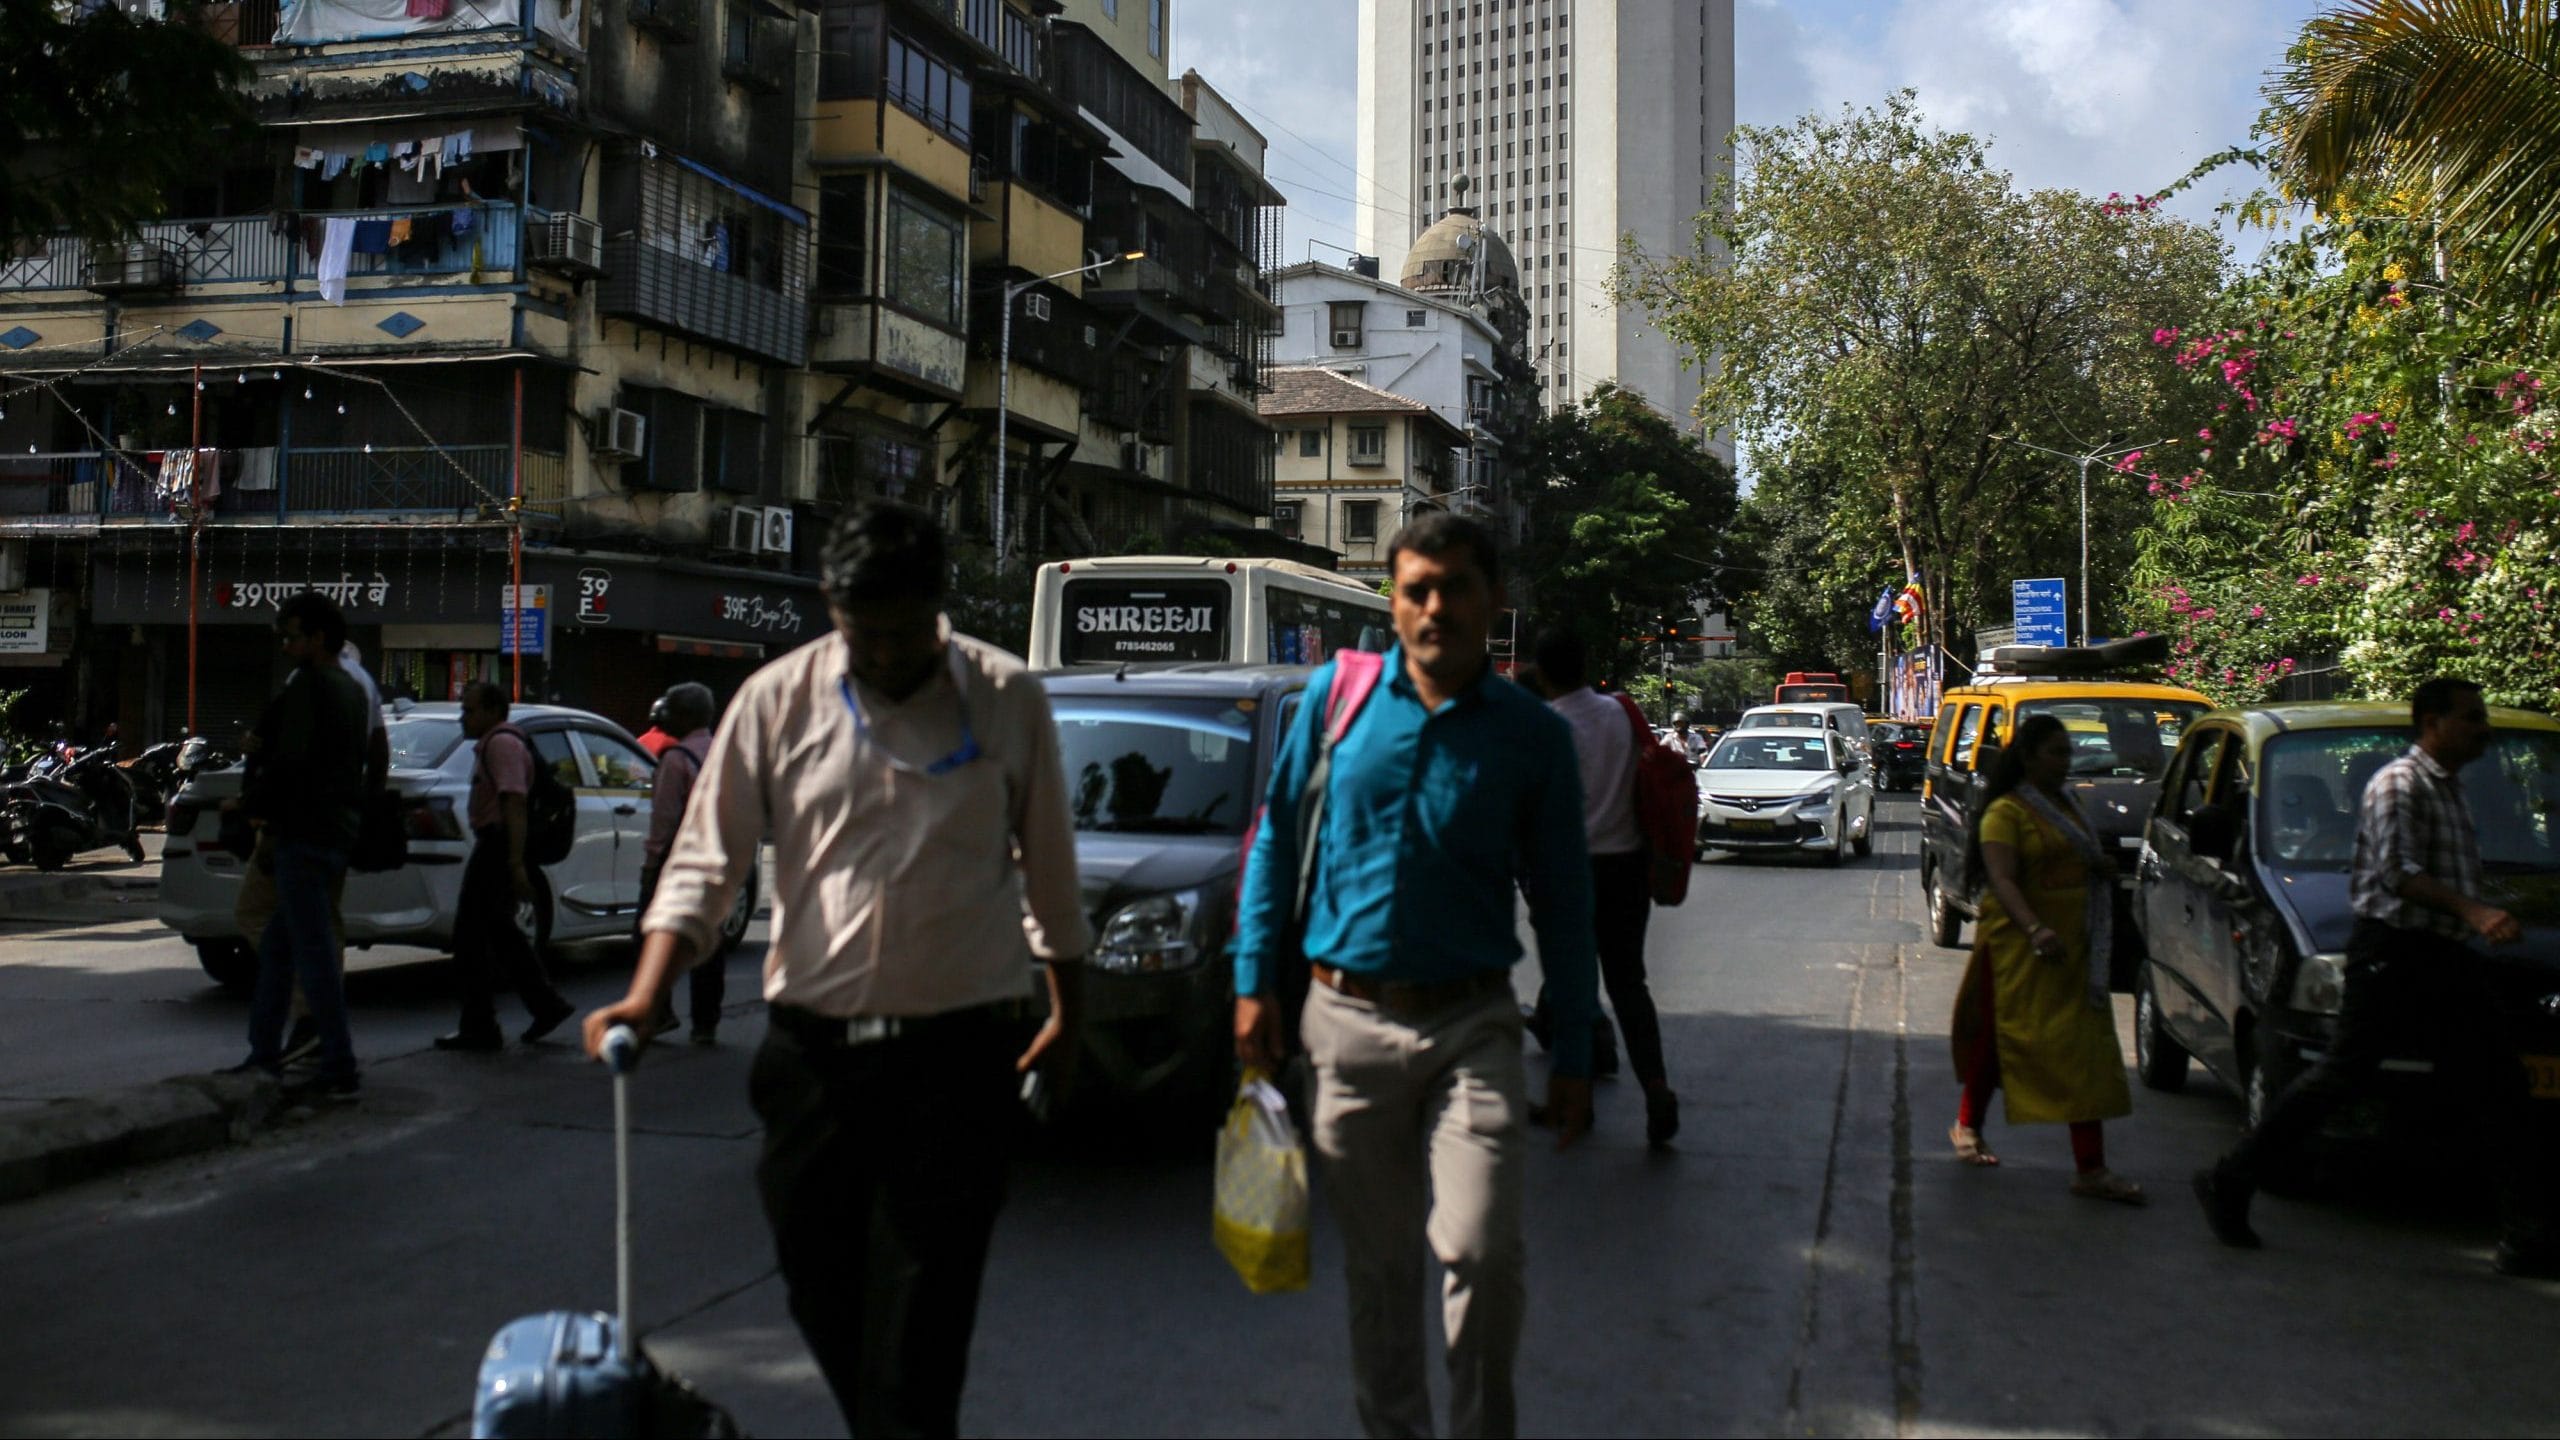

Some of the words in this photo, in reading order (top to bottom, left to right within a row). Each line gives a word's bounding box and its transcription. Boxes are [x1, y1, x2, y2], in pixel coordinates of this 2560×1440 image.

[368, 572, 390, 607] बे
[580, 576, 609, 597] 39
[580, 597, 593, 616] F
[1076, 606, 1213, 633] SHREEJI
